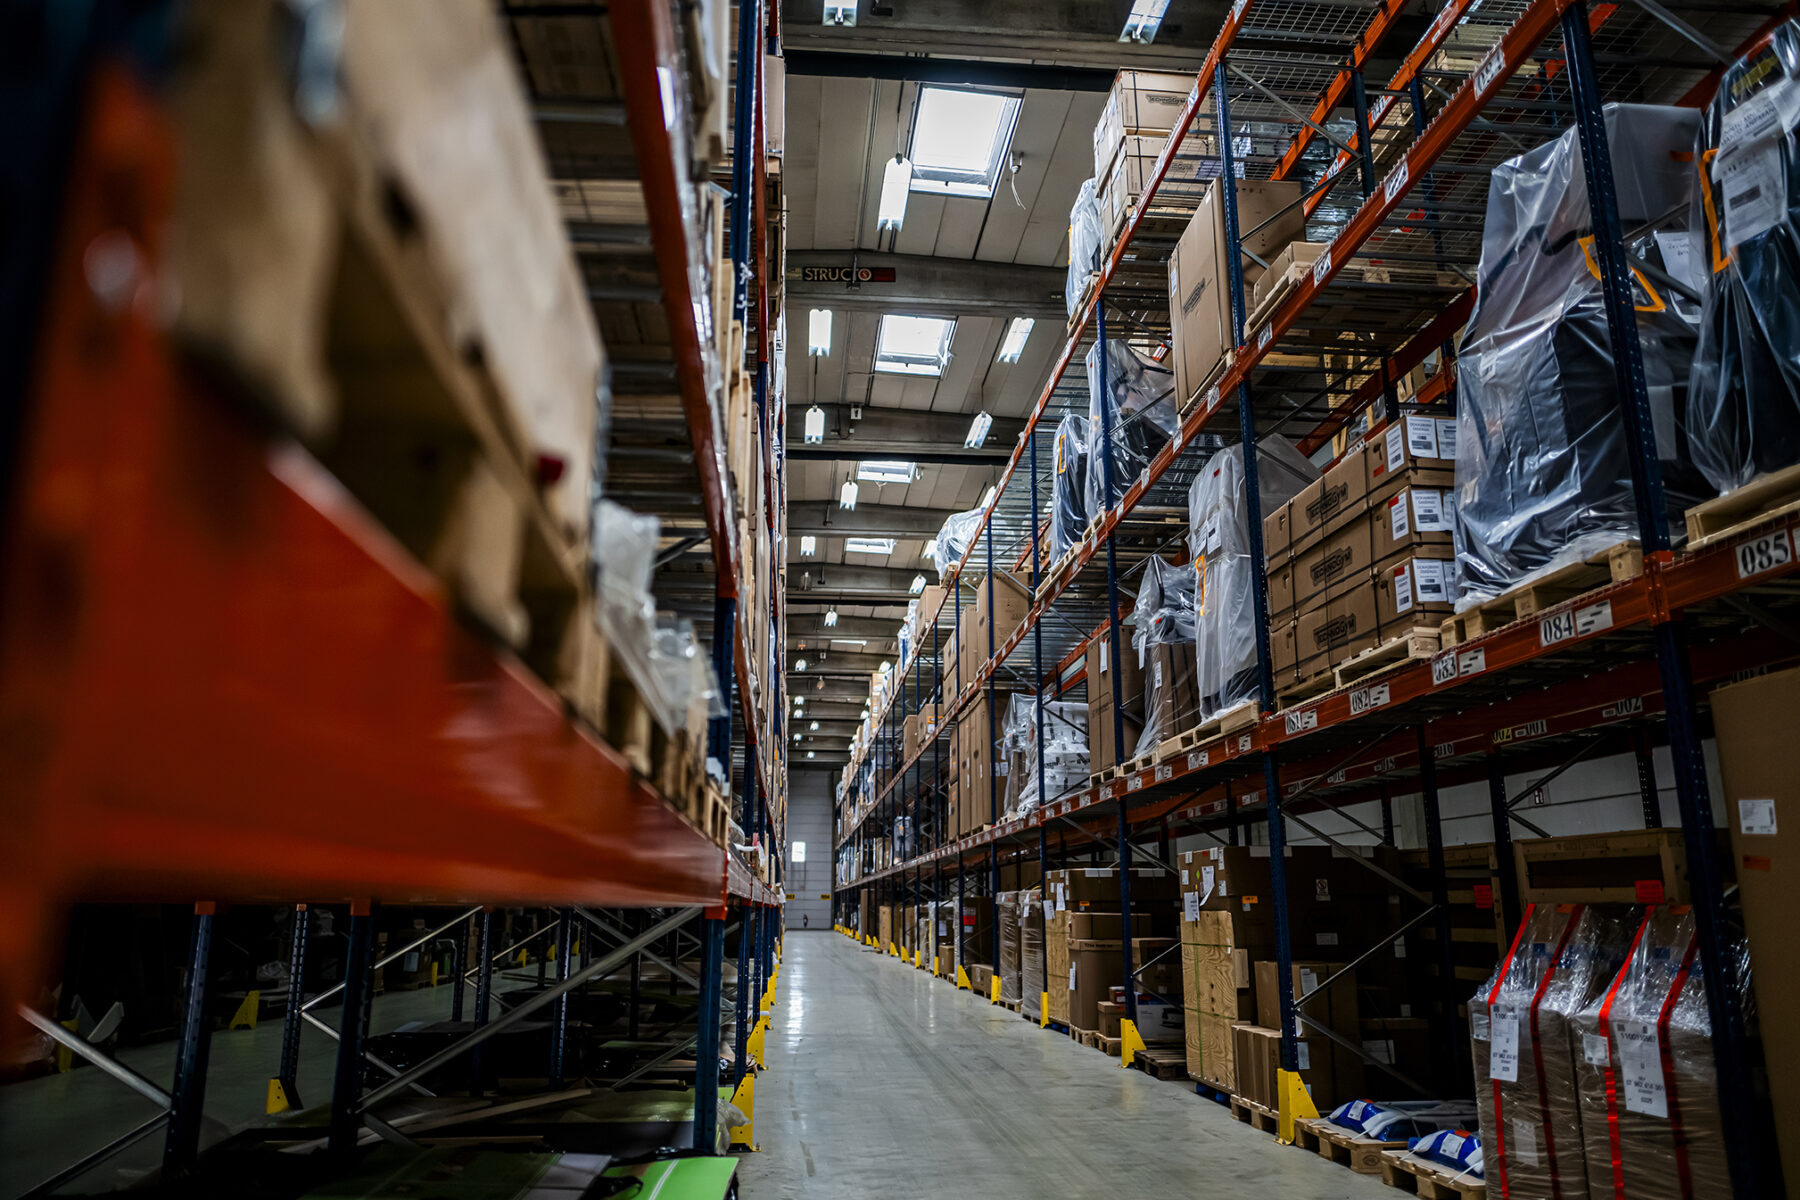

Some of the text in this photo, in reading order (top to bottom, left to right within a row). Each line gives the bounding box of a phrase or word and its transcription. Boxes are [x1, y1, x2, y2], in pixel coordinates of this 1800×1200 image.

[1741, 531, 1789, 575] 085
[1543, 611, 1573, 644] 084
[1351, 690, 1369, 713] 082
[1616, 699, 1642, 716] 002
[1525, 721, 1546, 737] 001
